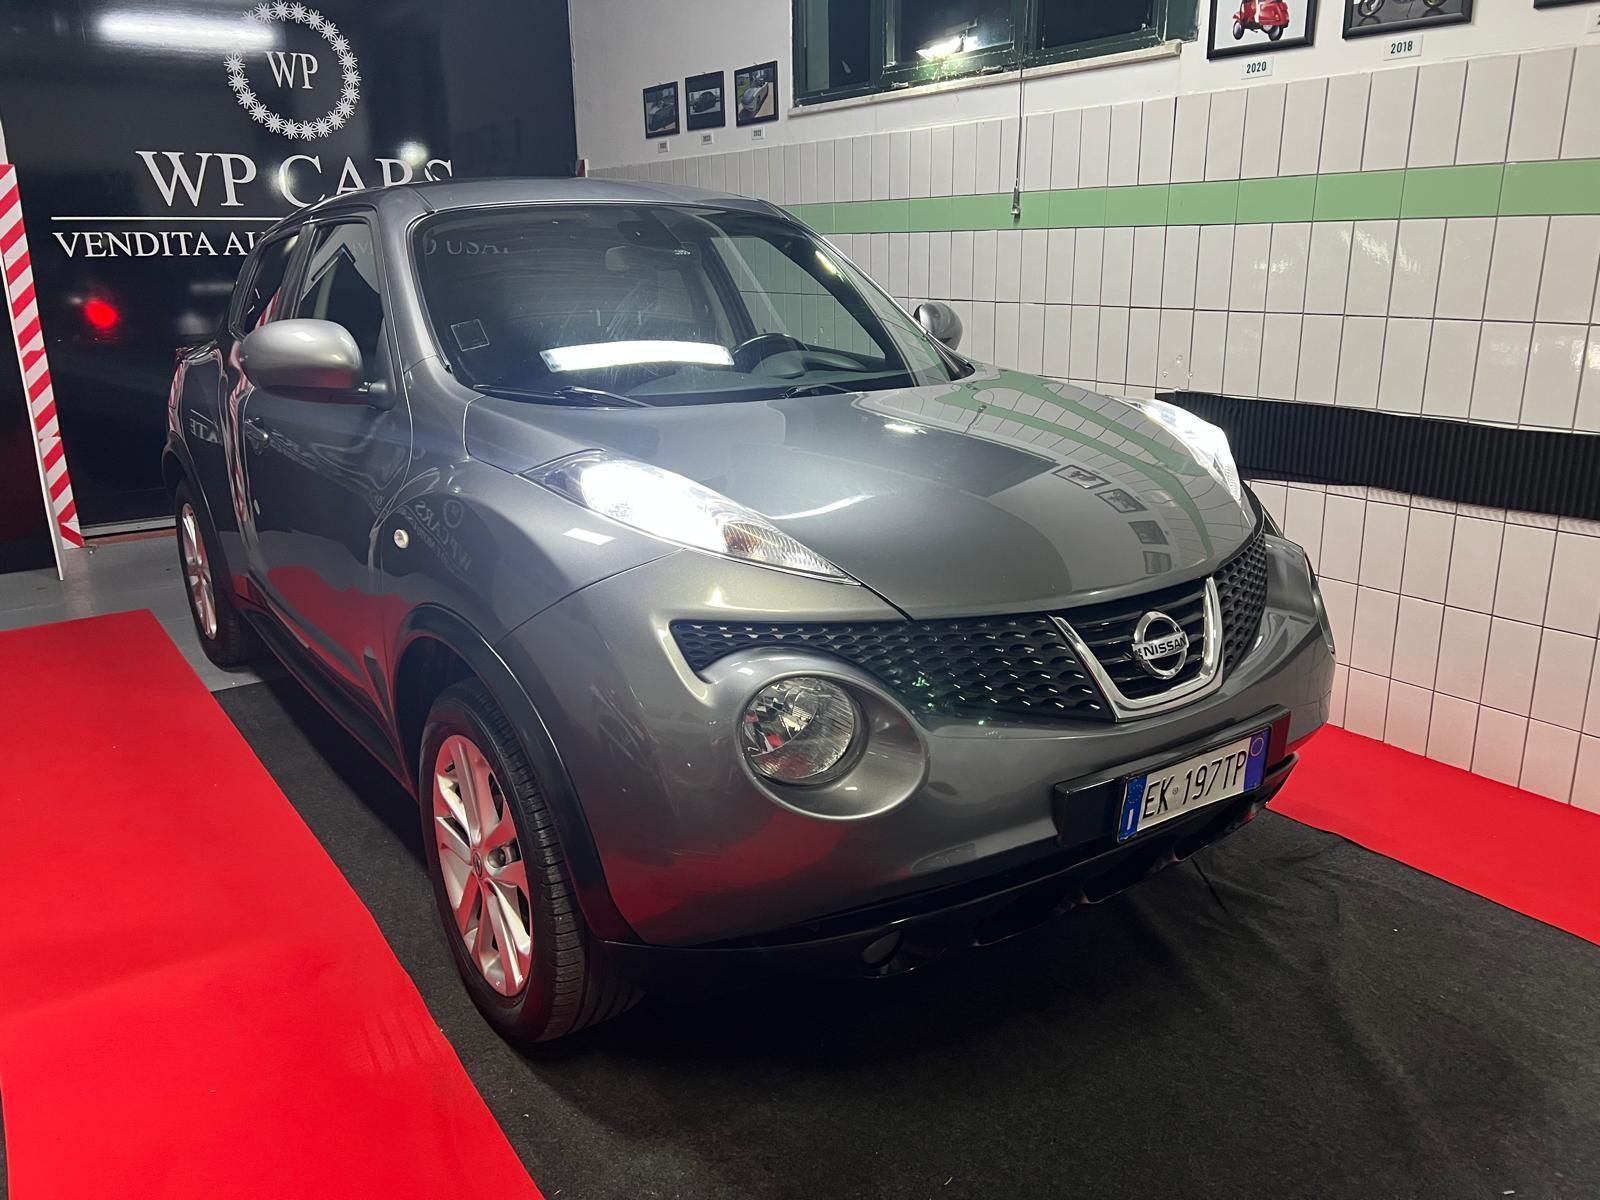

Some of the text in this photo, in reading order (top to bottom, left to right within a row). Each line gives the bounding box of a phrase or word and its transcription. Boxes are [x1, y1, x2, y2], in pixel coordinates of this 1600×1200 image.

[1390, 41, 1413, 54] 2018
[264, 51, 318, 89] WP
[1246, 61, 1267, 74] 2020
[136, 150, 257, 207] WP
[52, 231, 218, 258] VENDITA
[1143, 635, 1186, 657] NISSAN
[1143, 775, 1175, 819] EK
[1182, 750, 1247, 805] 197TP
